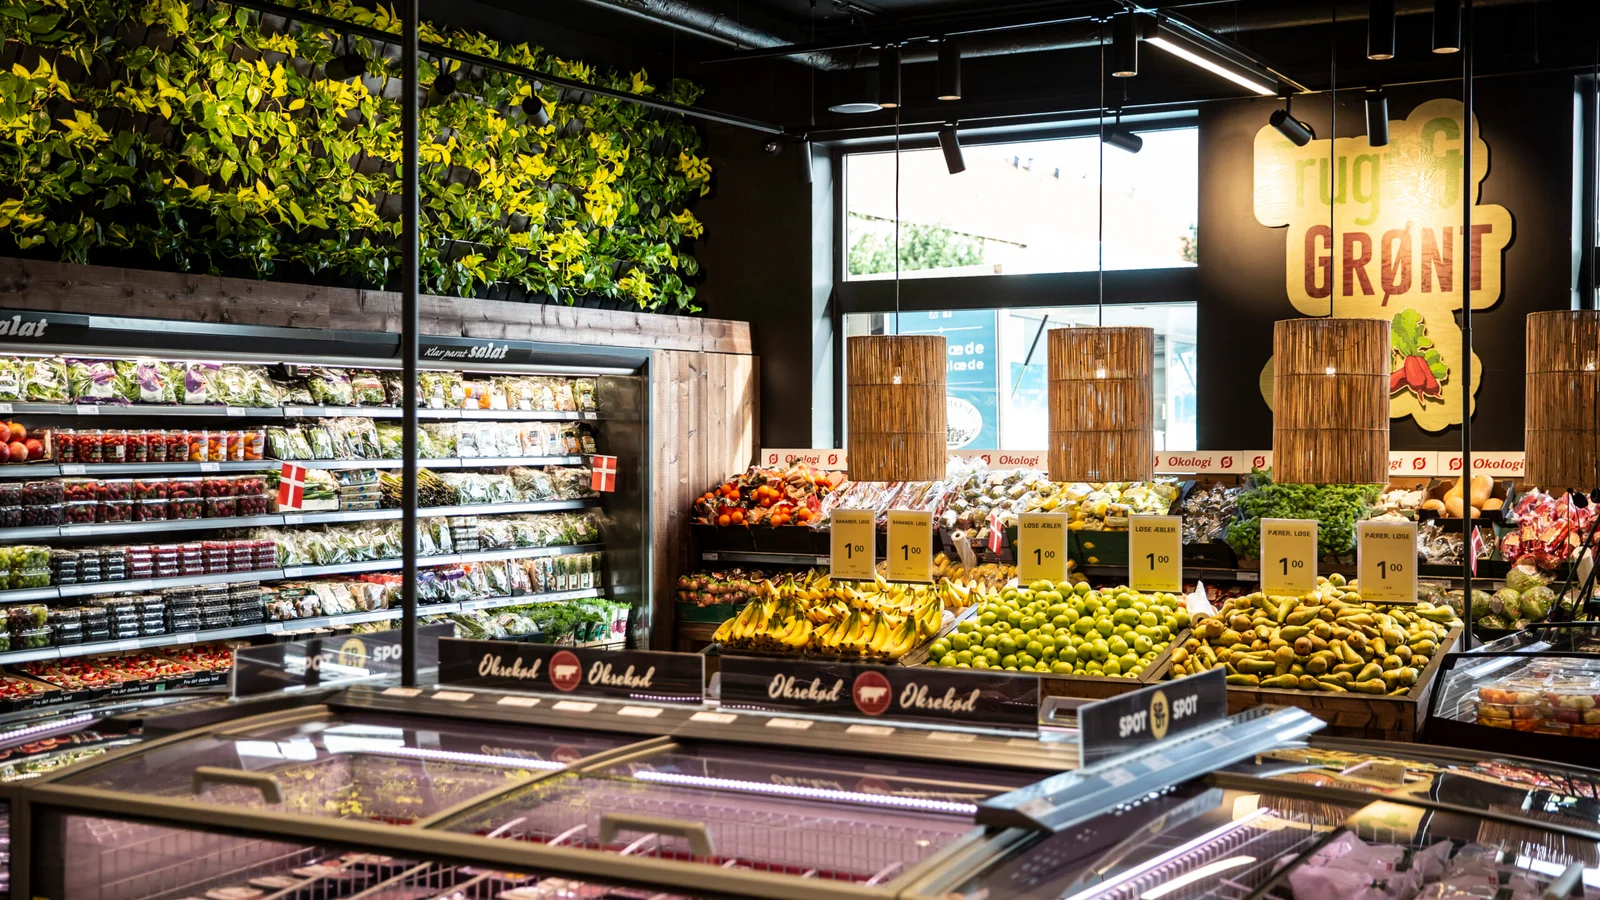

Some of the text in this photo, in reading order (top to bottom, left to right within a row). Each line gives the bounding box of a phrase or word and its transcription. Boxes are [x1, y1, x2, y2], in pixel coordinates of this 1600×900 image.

[1304, 222, 1493, 307] GRØNT
[0, 315, 48, 337] alat
[468, 342, 509, 359] salat
[947, 341, 985, 356] æde
[946, 359, 985, 372] læde
[999, 455, 1039, 467] Økologi
[1168, 456, 1212, 469] Økologi
[1473, 458, 1525, 471] Økologi
[373, 644, 402, 663] SPO
[478, 653, 656, 688] Oksekød Oksekød
[767, 672, 981, 712] Oksekød Oksekød
[1119, 694, 1198, 738] SPOT SPOT
